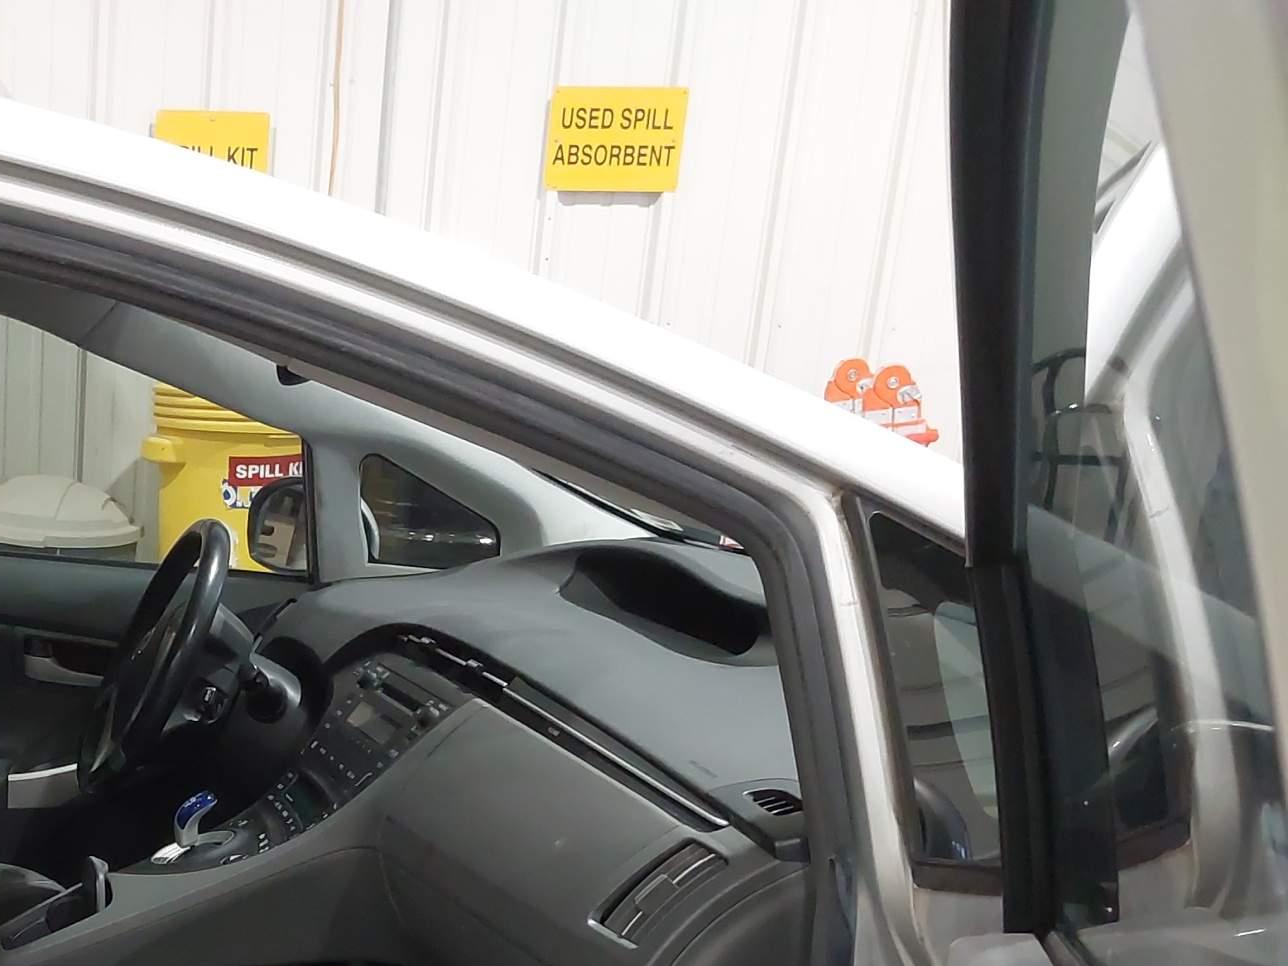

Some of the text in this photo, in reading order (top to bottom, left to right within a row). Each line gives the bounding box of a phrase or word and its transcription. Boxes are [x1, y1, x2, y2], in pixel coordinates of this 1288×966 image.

[561, 107, 673, 131] USED SPILL
[227, 146, 258, 169] KIT
[552, 144, 675, 167] ABSORBENT
[235, 463, 284, 479] SPILL
